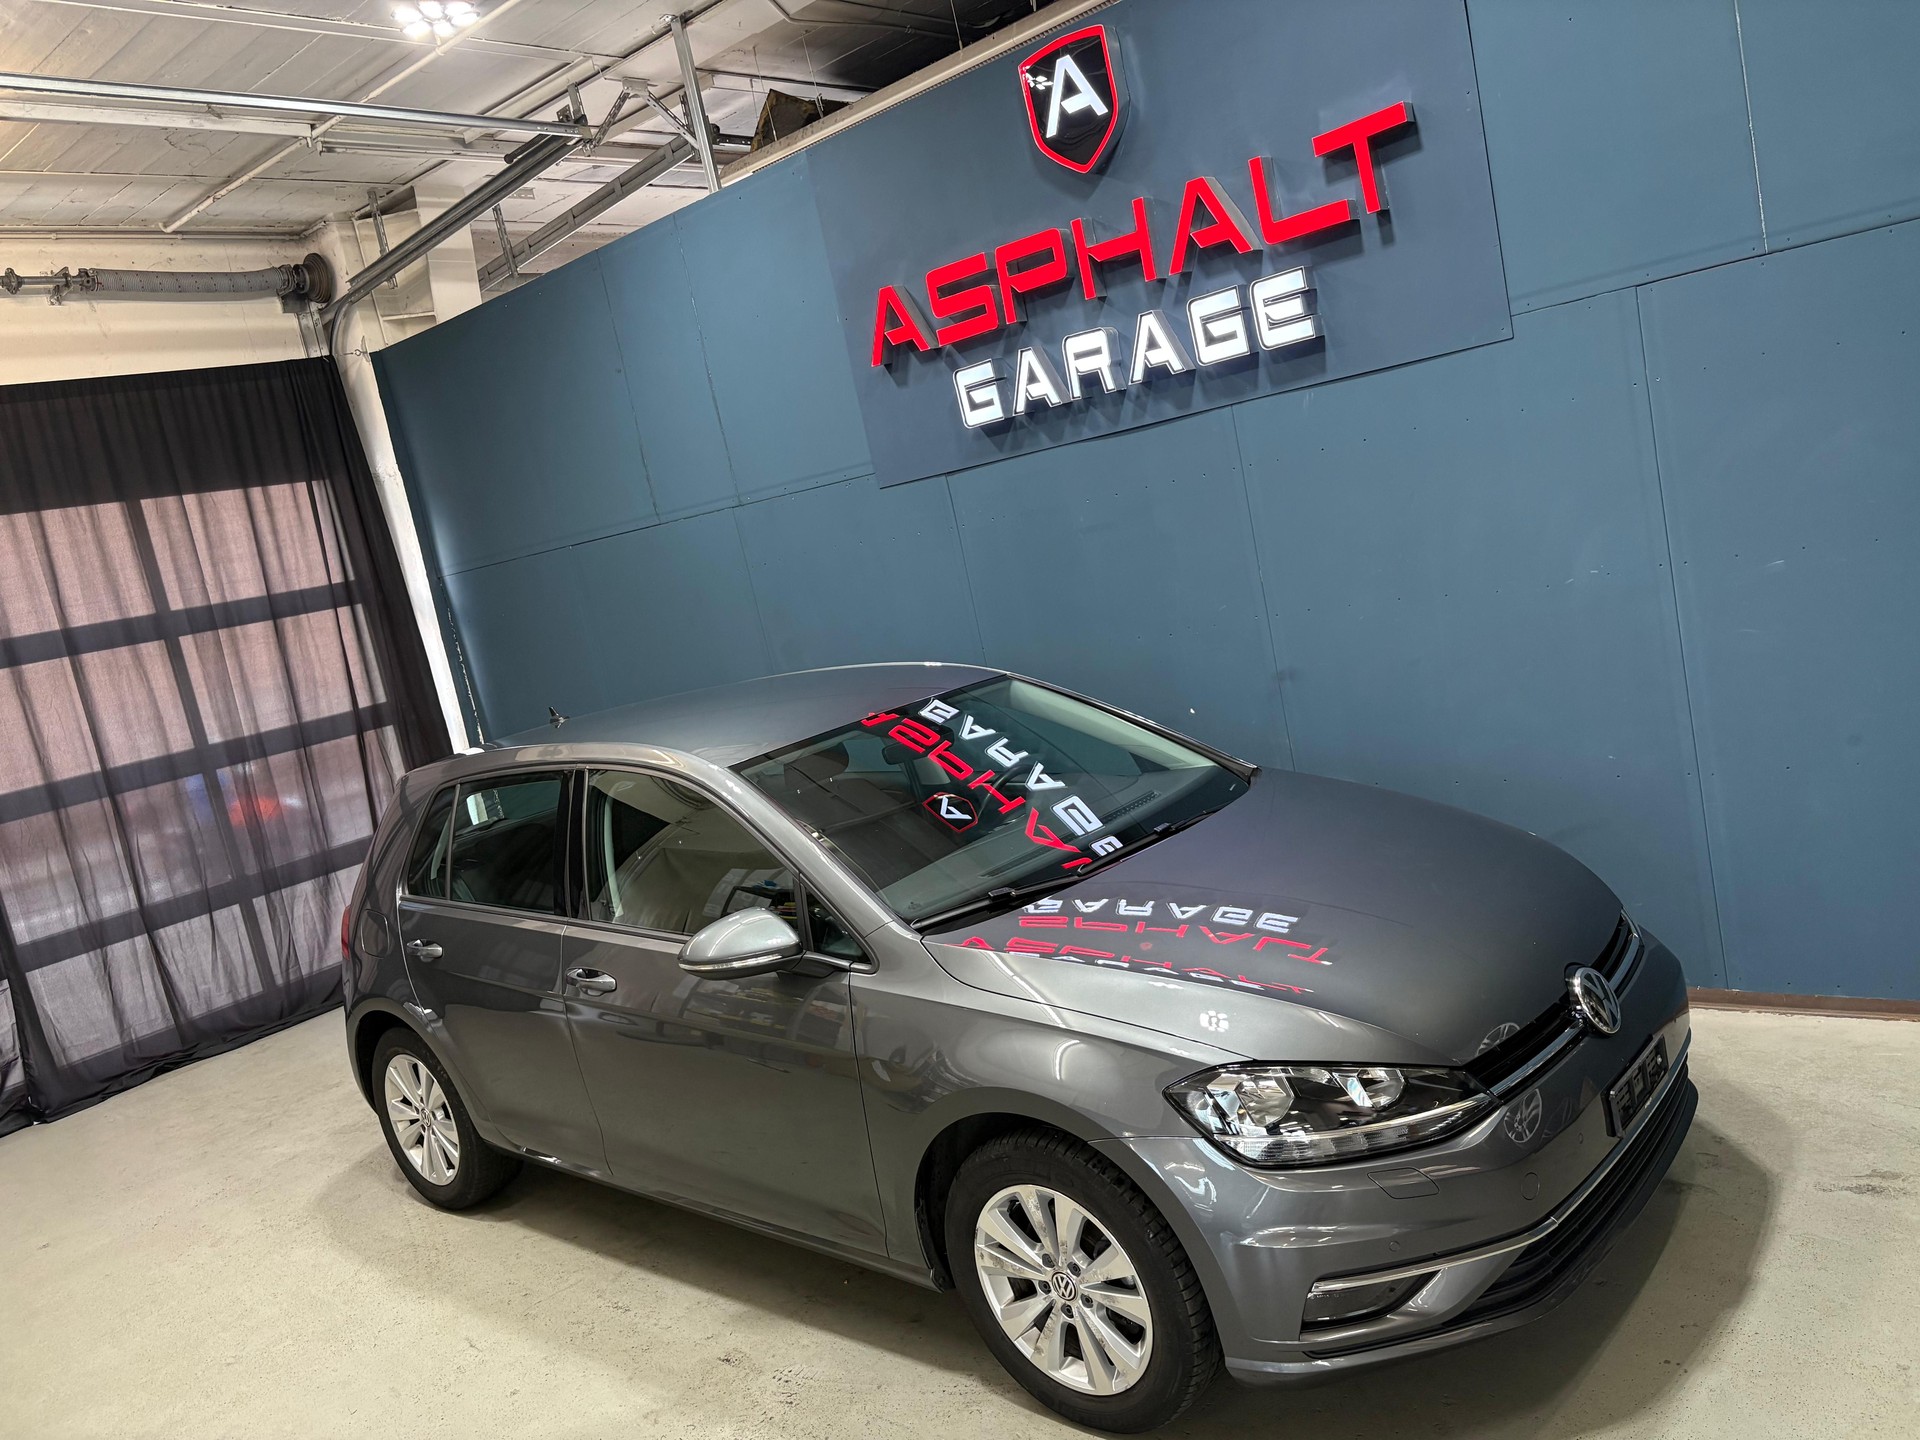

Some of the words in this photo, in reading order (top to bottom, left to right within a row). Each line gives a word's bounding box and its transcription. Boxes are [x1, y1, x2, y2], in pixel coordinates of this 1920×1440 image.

[1046, 54, 1109, 138] A
[871, 101, 1413, 367] ASPHALT
[952, 266, 1318, 429] GARAGE
